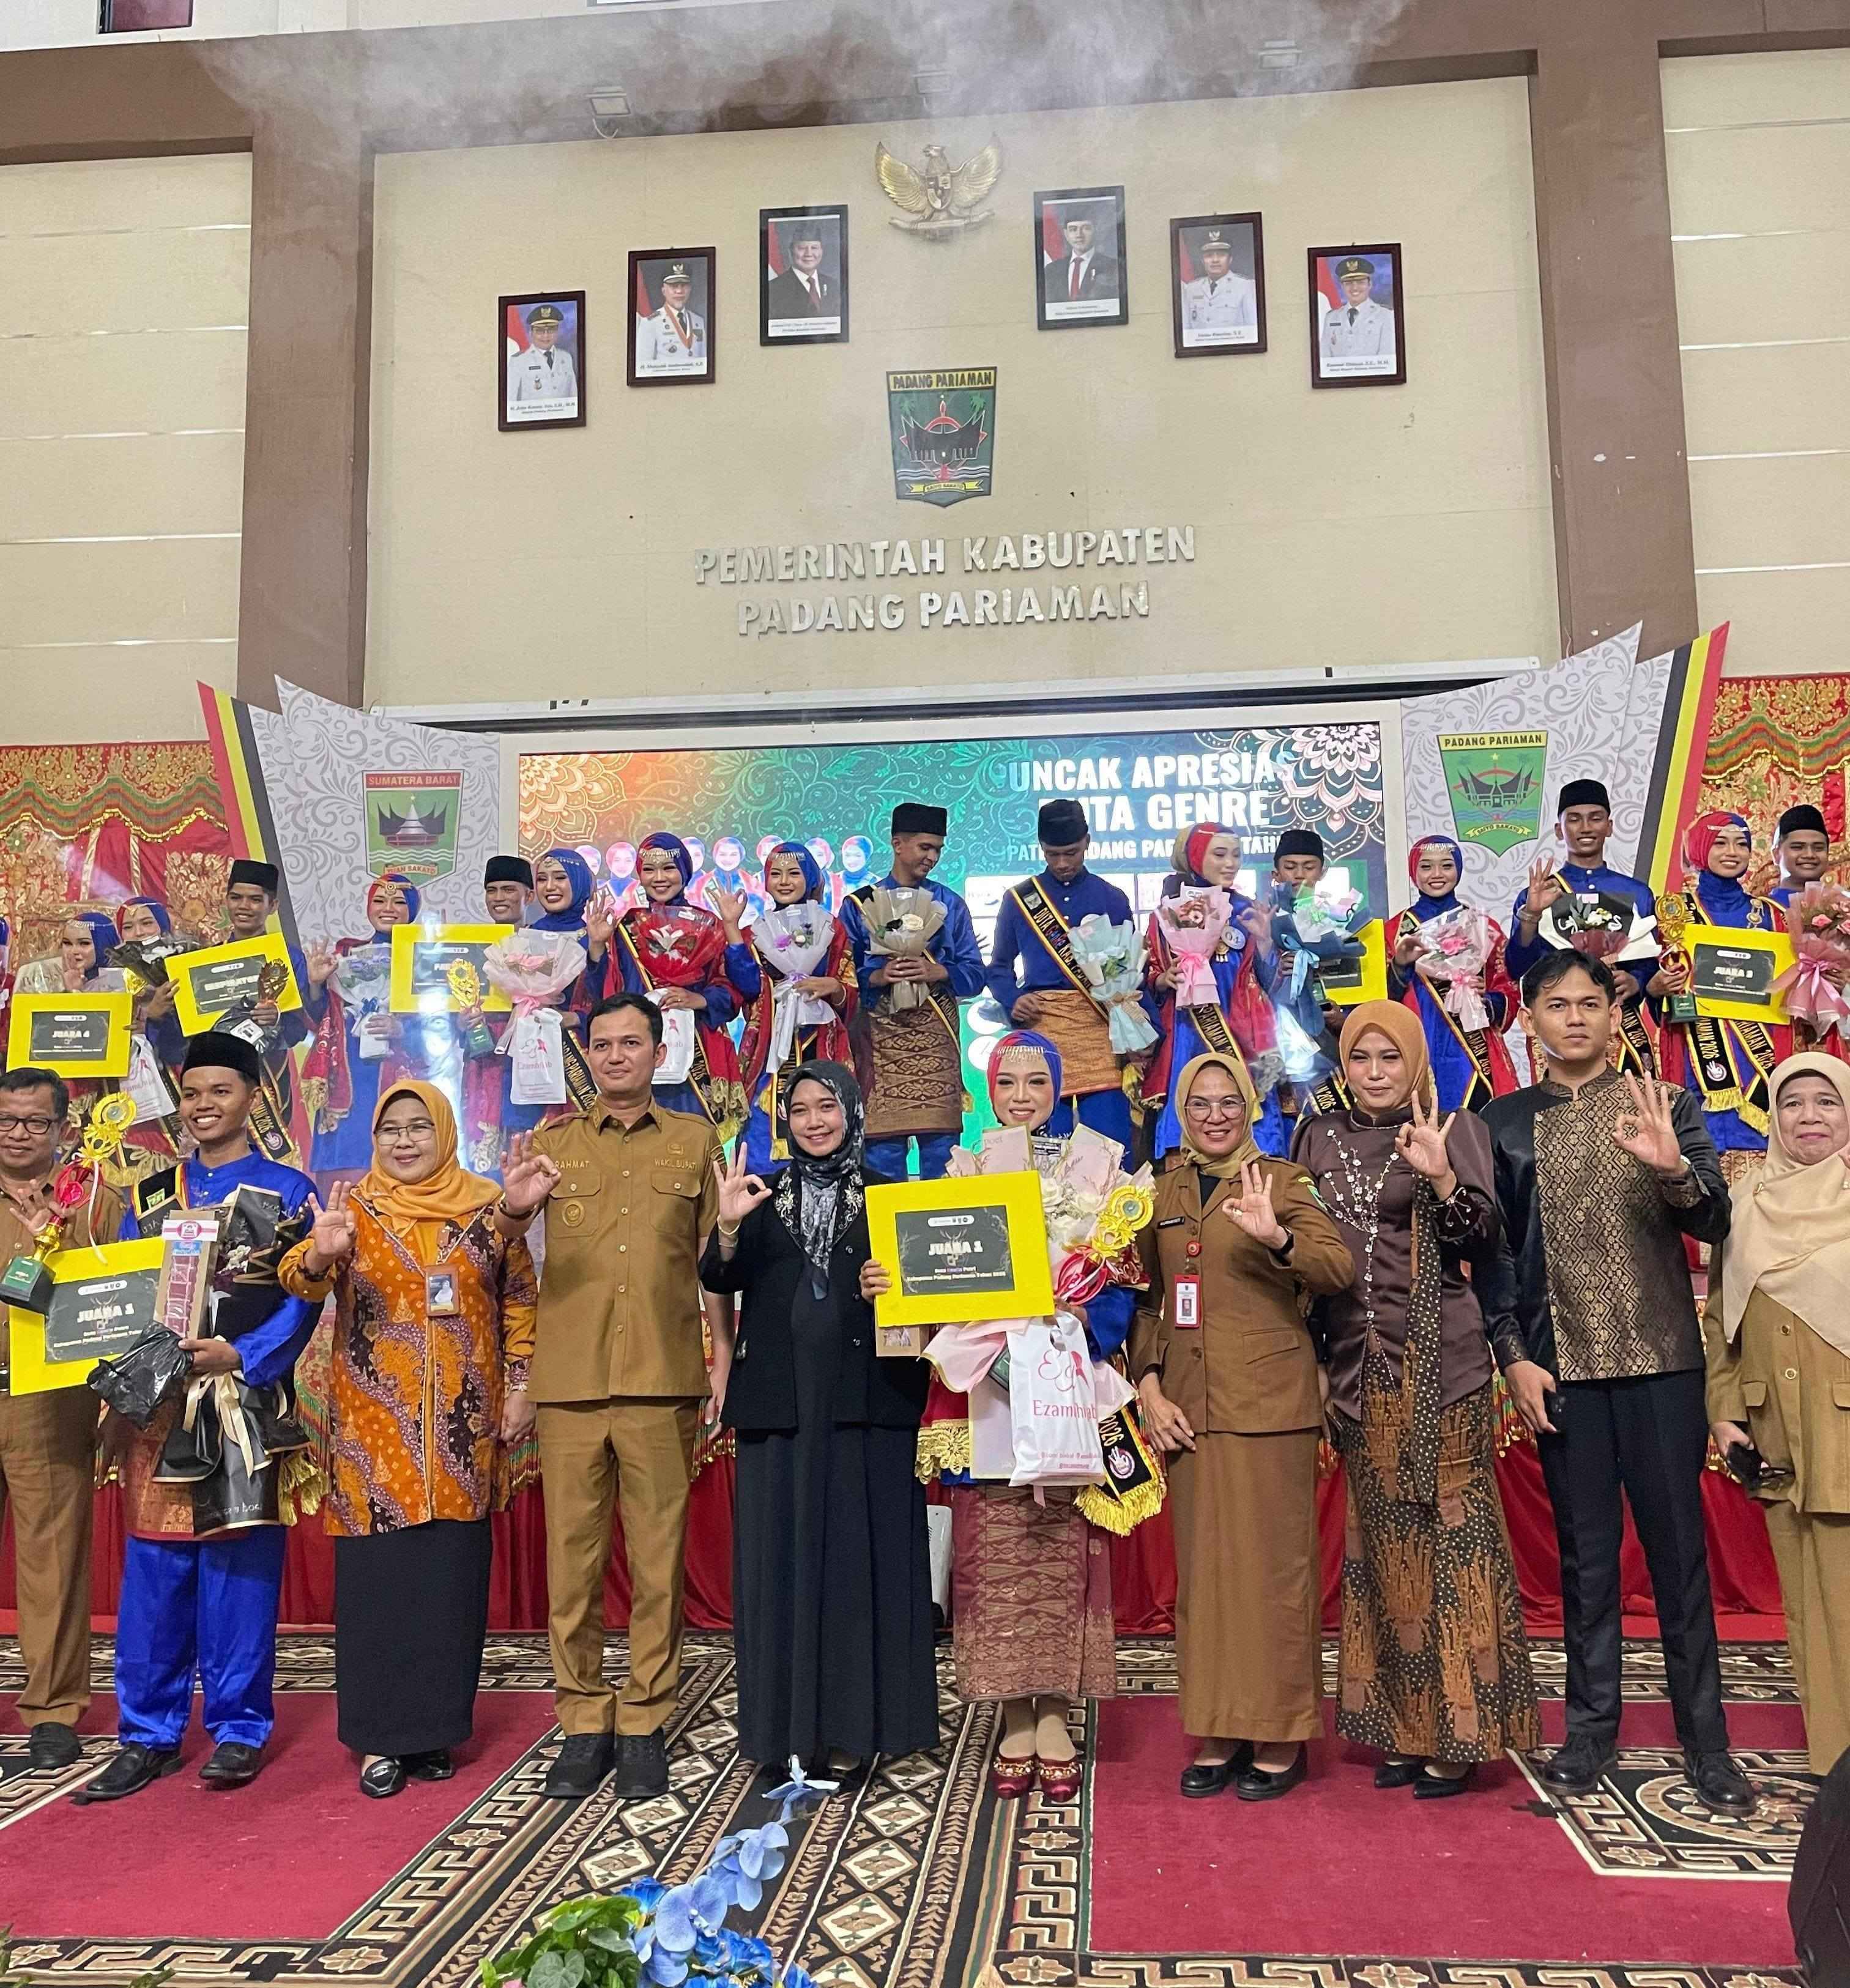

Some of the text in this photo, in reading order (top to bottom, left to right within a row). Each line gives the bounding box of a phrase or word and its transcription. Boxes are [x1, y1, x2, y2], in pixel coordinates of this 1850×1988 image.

[893, 371, 992, 388] PADANG PARIAMAN
[694, 524, 1196, 585] PEMERINTAH KABUPATEN
[737, 580, 1151, 636] PADANG PARIAMAN
[1444, 734, 1542, 747] PADANG PARIAMAN
[368, 775, 458, 785] SUMATERA BARAT
[1147, 790, 1270, 830] GENRE
[1033, 907, 1055, 932] DUTA
[1699, 1040, 1720, 1059] 2026
[1316, 1091, 1337, 1110] 2026
[555, 1160, 590, 1169] RAHMAT
[928, 1241, 972, 1256] JUARA
[76, 1305, 123, 1323] JUARA
